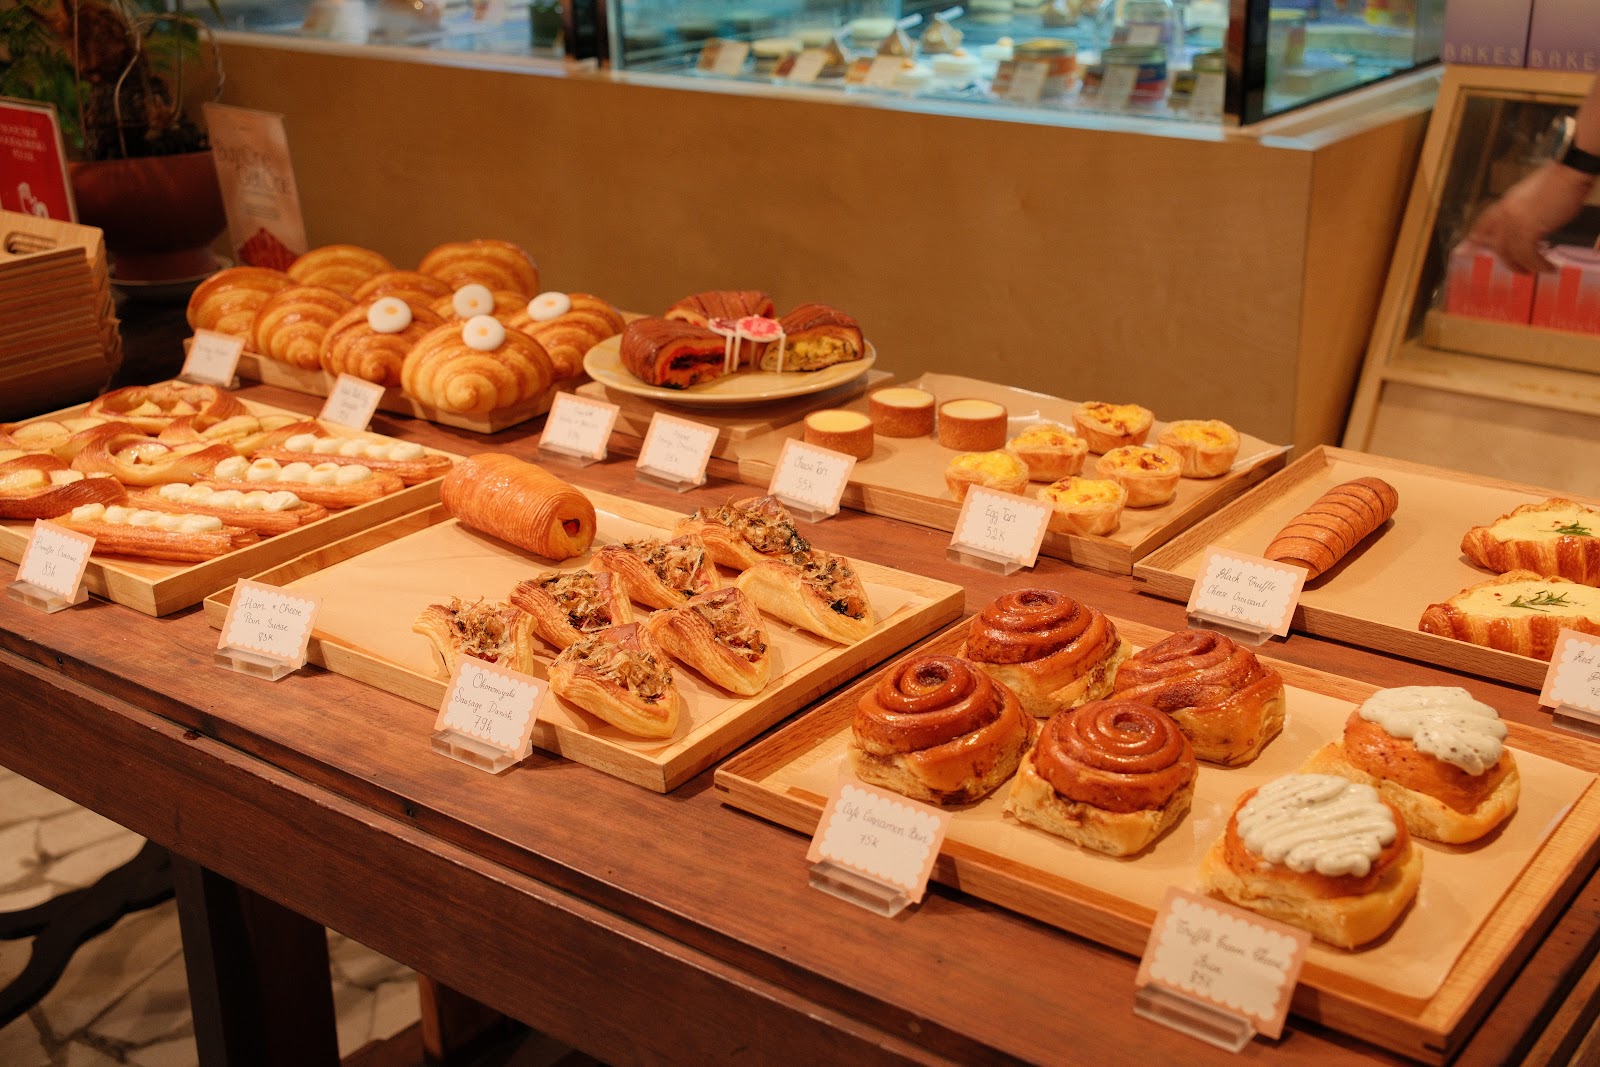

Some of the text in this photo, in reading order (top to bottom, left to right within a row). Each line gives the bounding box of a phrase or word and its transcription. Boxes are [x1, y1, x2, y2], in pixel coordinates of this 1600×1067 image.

[985, 504, 1017, 525] Egg Tart
[1216, 567, 1277, 593] Black Truffle
[240, 597, 266, 610] Ham
[278, 603, 302, 617] Cheese
[1206, 584, 1268, 608] Cheese Croissant
[1573, 650, 1596, 665] Red
[454, 687, 514, 721] Sausage Danish
